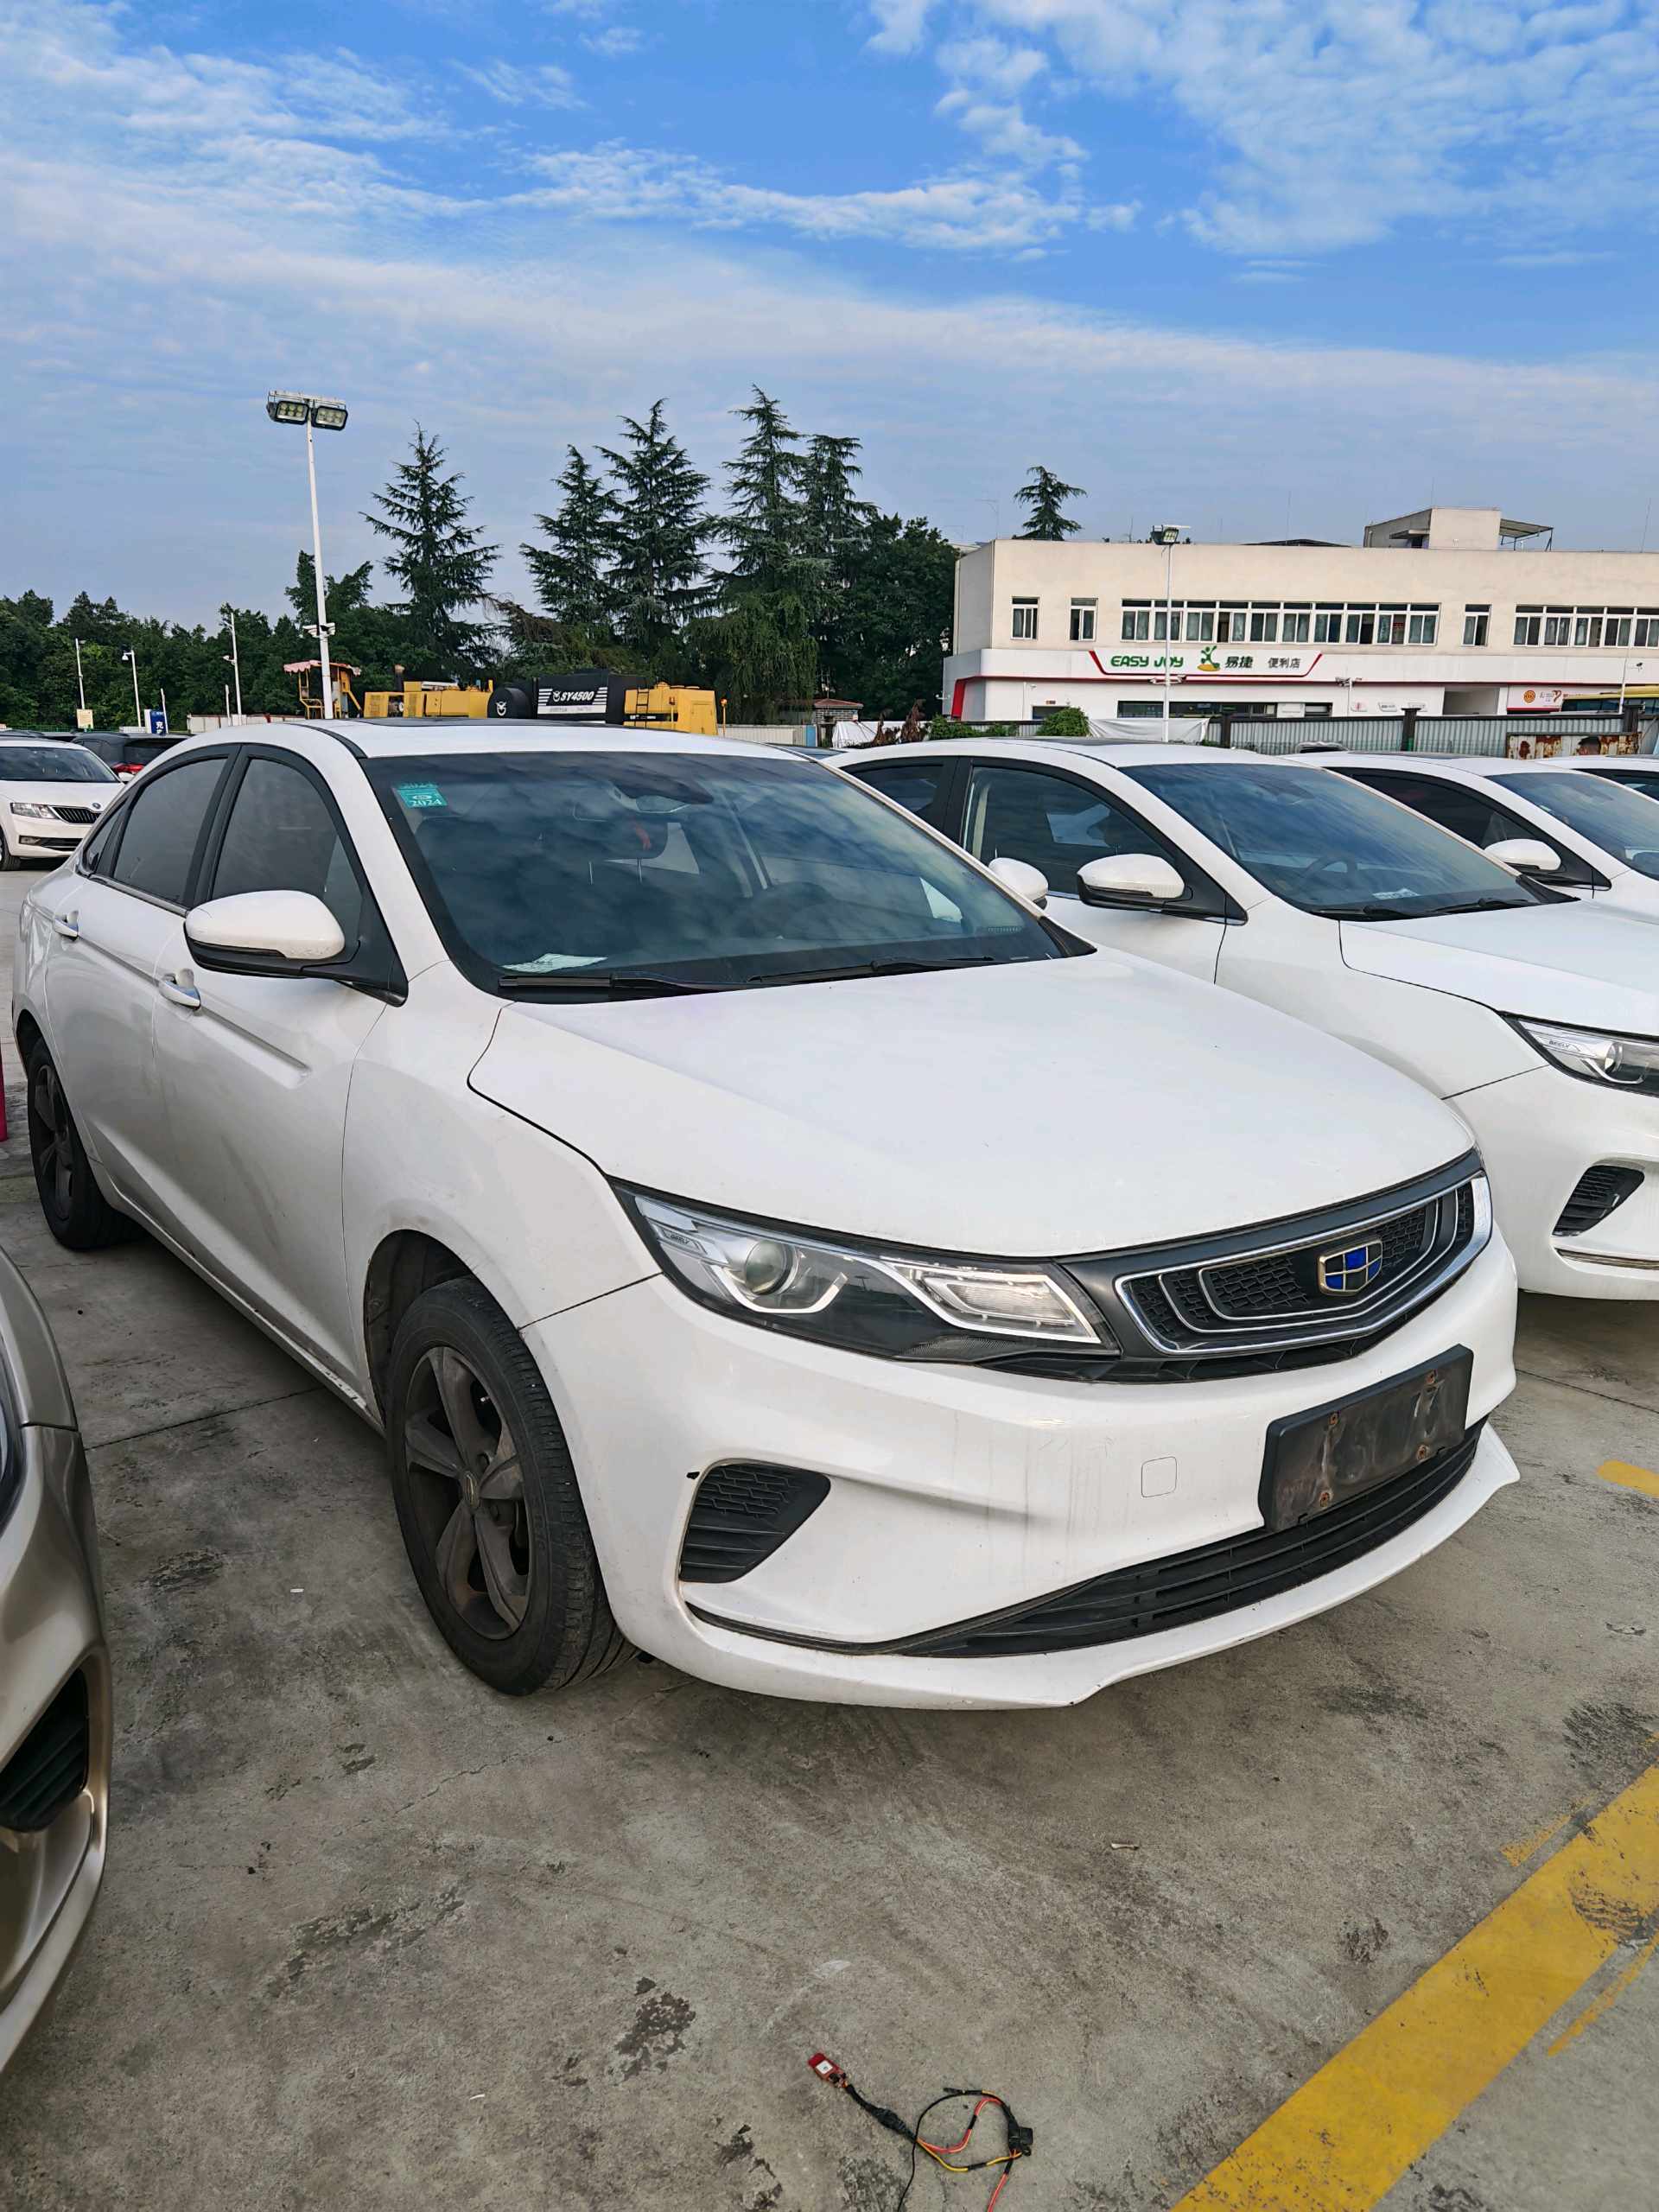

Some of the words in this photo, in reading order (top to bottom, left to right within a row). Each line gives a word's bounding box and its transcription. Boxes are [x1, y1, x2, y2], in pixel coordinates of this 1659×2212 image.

[1110, 655, 1149, 668] EASY
[1154, 656, 1184, 668] JOY
[1224, 656, 1254, 669] 易捷
[1268, 657, 1301, 669] 便利店
[560, 691, 595, 702] SY4500
[410, 799, 442, 808] 2024
